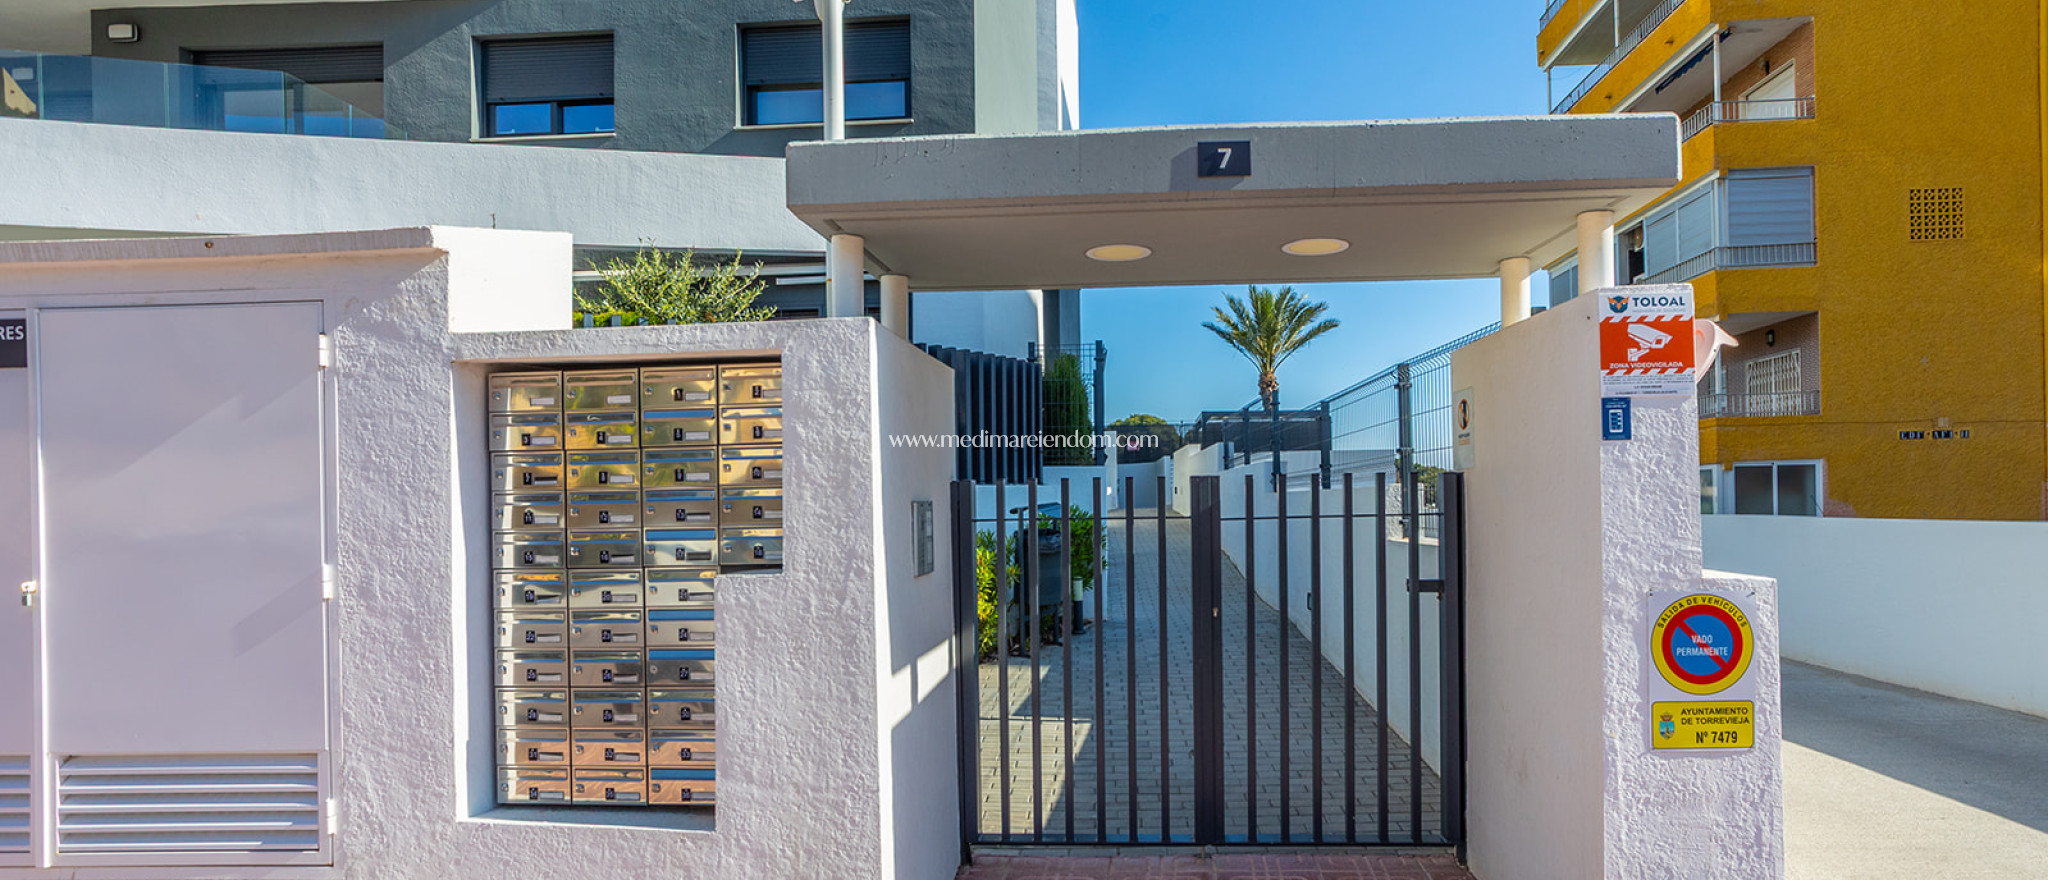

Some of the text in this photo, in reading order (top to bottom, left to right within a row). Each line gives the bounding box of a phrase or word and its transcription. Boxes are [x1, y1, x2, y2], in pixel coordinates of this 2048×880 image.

[1217, 147, 1232, 169] 7
[1632, 296, 1686, 307] TOLOAL
[1630, 361, 1684, 369] VIDEOVIGILADA
[1658, 602, 1684, 628] SALIDA
[1686, 597, 1697, 605] DE
[1691, 634, 1713, 643] VADO
[1676, 647, 1728, 656] PERMANENTE
[1681, 707, 1748, 715] AYUNTAMIENTO
[1681, 716, 1750, 725] DE TORREVIEJA
[1711, 731, 1738, 743] 7479
